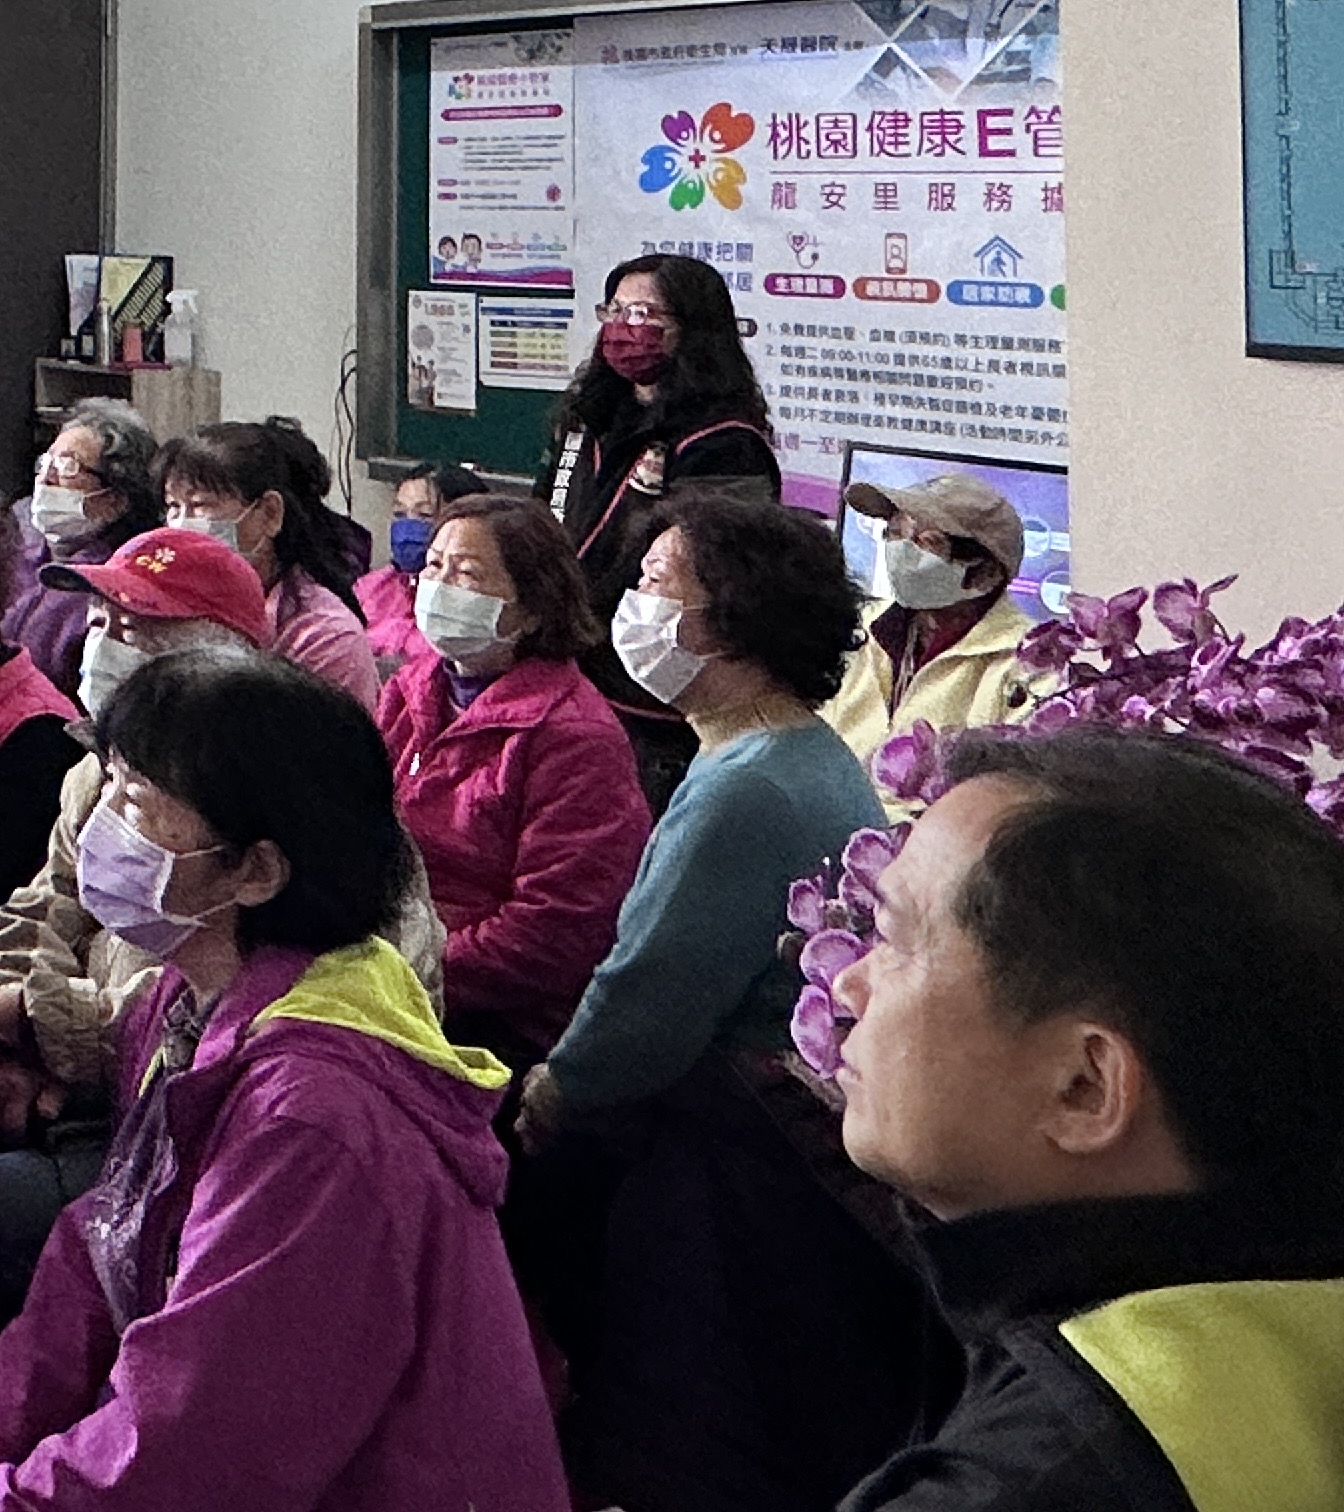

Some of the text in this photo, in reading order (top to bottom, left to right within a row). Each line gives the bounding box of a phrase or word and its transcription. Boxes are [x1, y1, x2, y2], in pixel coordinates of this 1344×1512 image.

[766, 104, 1063, 161] 桃園健康E管
[770, 180, 1064, 213] 龍安里服務據
